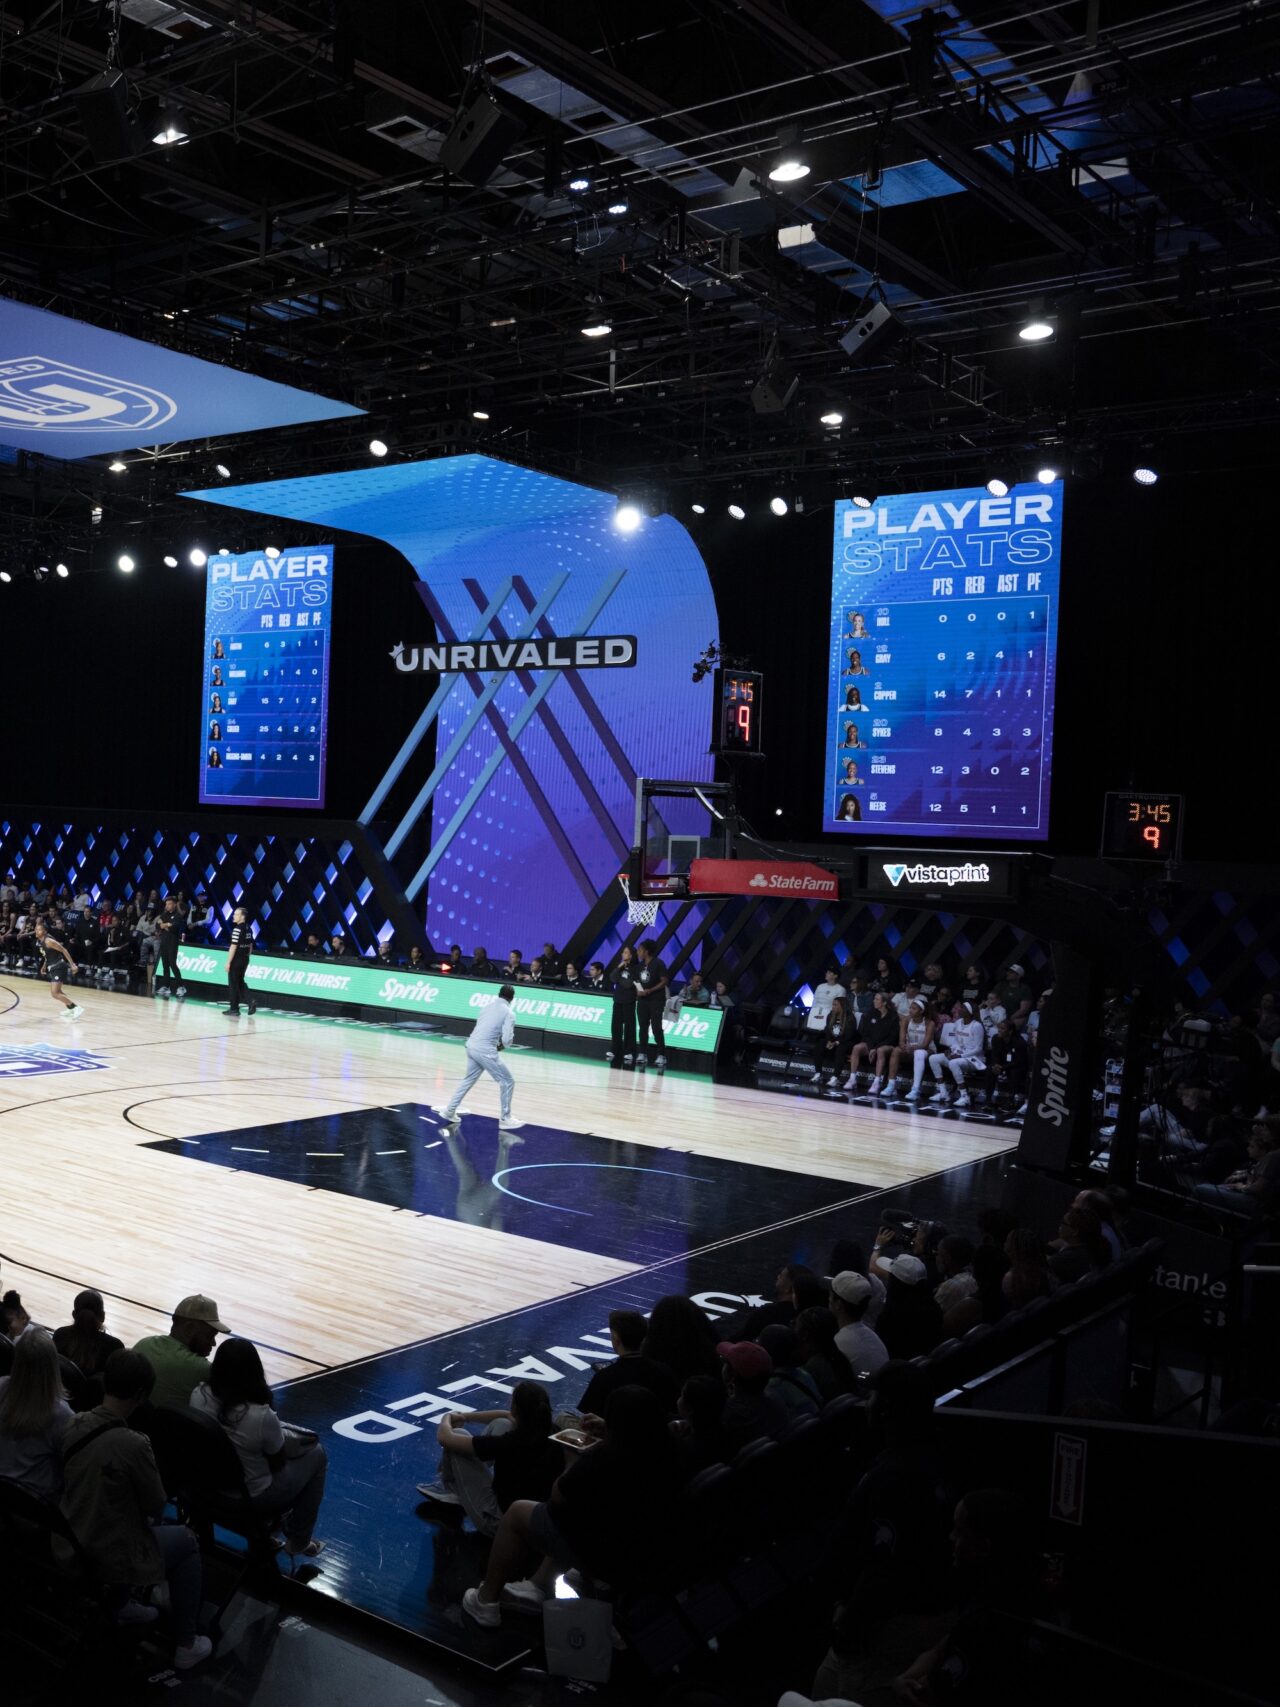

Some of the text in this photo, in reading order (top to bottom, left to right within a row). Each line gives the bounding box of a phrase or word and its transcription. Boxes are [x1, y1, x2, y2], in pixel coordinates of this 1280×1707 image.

[843, 494, 1054, 538] PLAYER
[843, 529, 1054, 576] STATS
[211, 554, 328, 585] PLAYER
[212, 579, 328, 612] STATS
[932, 572, 1042, 596] PTS REB AST PF
[261, 614, 274, 628] PTS
[296, 612, 310, 626] AST
[313, 611, 322, 626] PF
[877, 608, 889, 616] 10
[938, 614, 948, 624] 0
[967, 613, 976, 622] 0
[996, 612, 1006, 621] 0
[1029, 610, 1035, 620] 1
[395, 637, 634, 672] UNRIVALED
[937, 652, 946, 661] 6
[966, 651, 975, 660] 2
[995, 650, 1004, 660] 4
[1028, 650, 1034, 659] 1
[874, 689, 1032, 700] COPPER 14 7 1 1
[738, 705, 750, 742] 9
[872, 727, 1032, 738] SYKES 8 4 3 3
[871, 764, 1030, 776] STEVENS 12 3 0 2
[869, 801, 1027, 815] REESE 12 5 1 1
[1128, 803, 1170, 823] 3:45
[1143, 826, 1160, 849] 9
[769, 872, 835, 892] StateFarm
[906, 863, 990, 886] vistaprint
[273, 968, 305, 984] YOUR
[305, 972, 352, 991] THIRST.
[378, 978, 439, 1003] Sprite
[510, 997, 549, 1016] YOUR
[549, 1002, 605, 1025] THIRST.
[1036, 1045, 1070, 1127] Sprite
